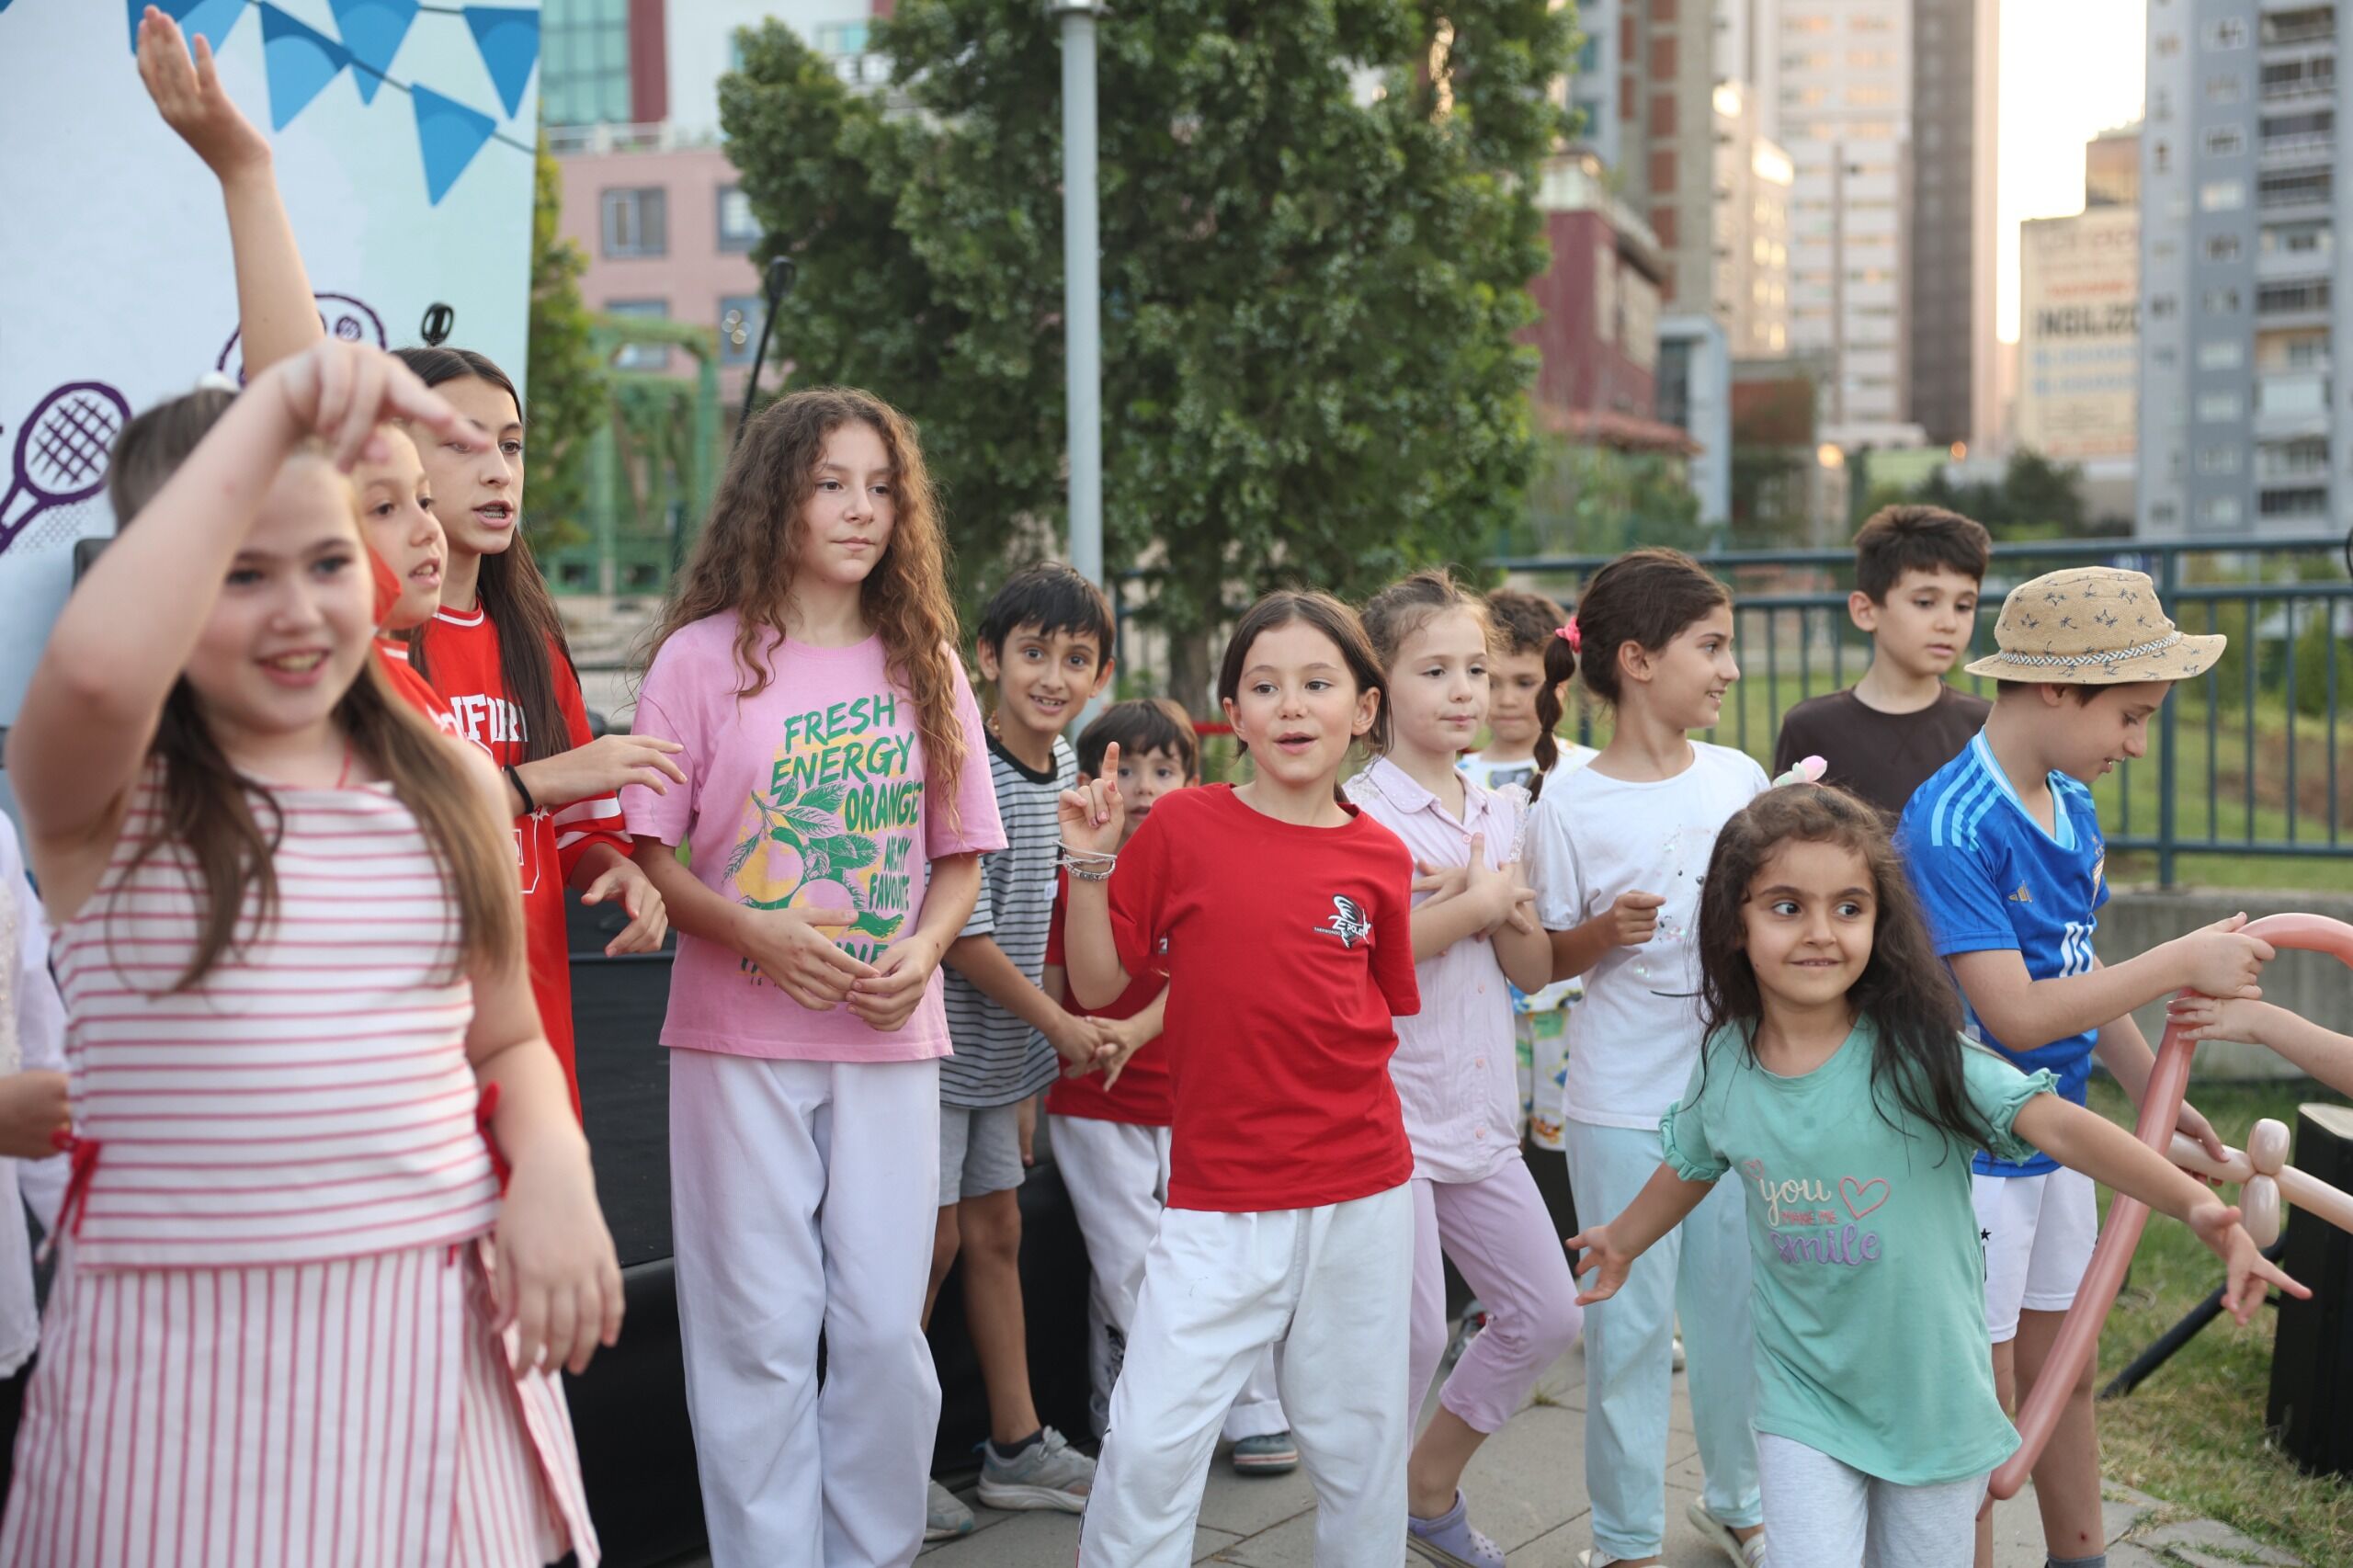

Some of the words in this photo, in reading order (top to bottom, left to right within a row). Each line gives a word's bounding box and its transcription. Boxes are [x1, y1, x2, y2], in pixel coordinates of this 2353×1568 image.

[783, 692, 896, 754] FRESH
[769, 731, 915, 796] ENERGY
[1759, 1178, 1832, 1227] you
[1818, 1209, 1839, 1224] ME
[1768, 1222, 1881, 1266] smile
